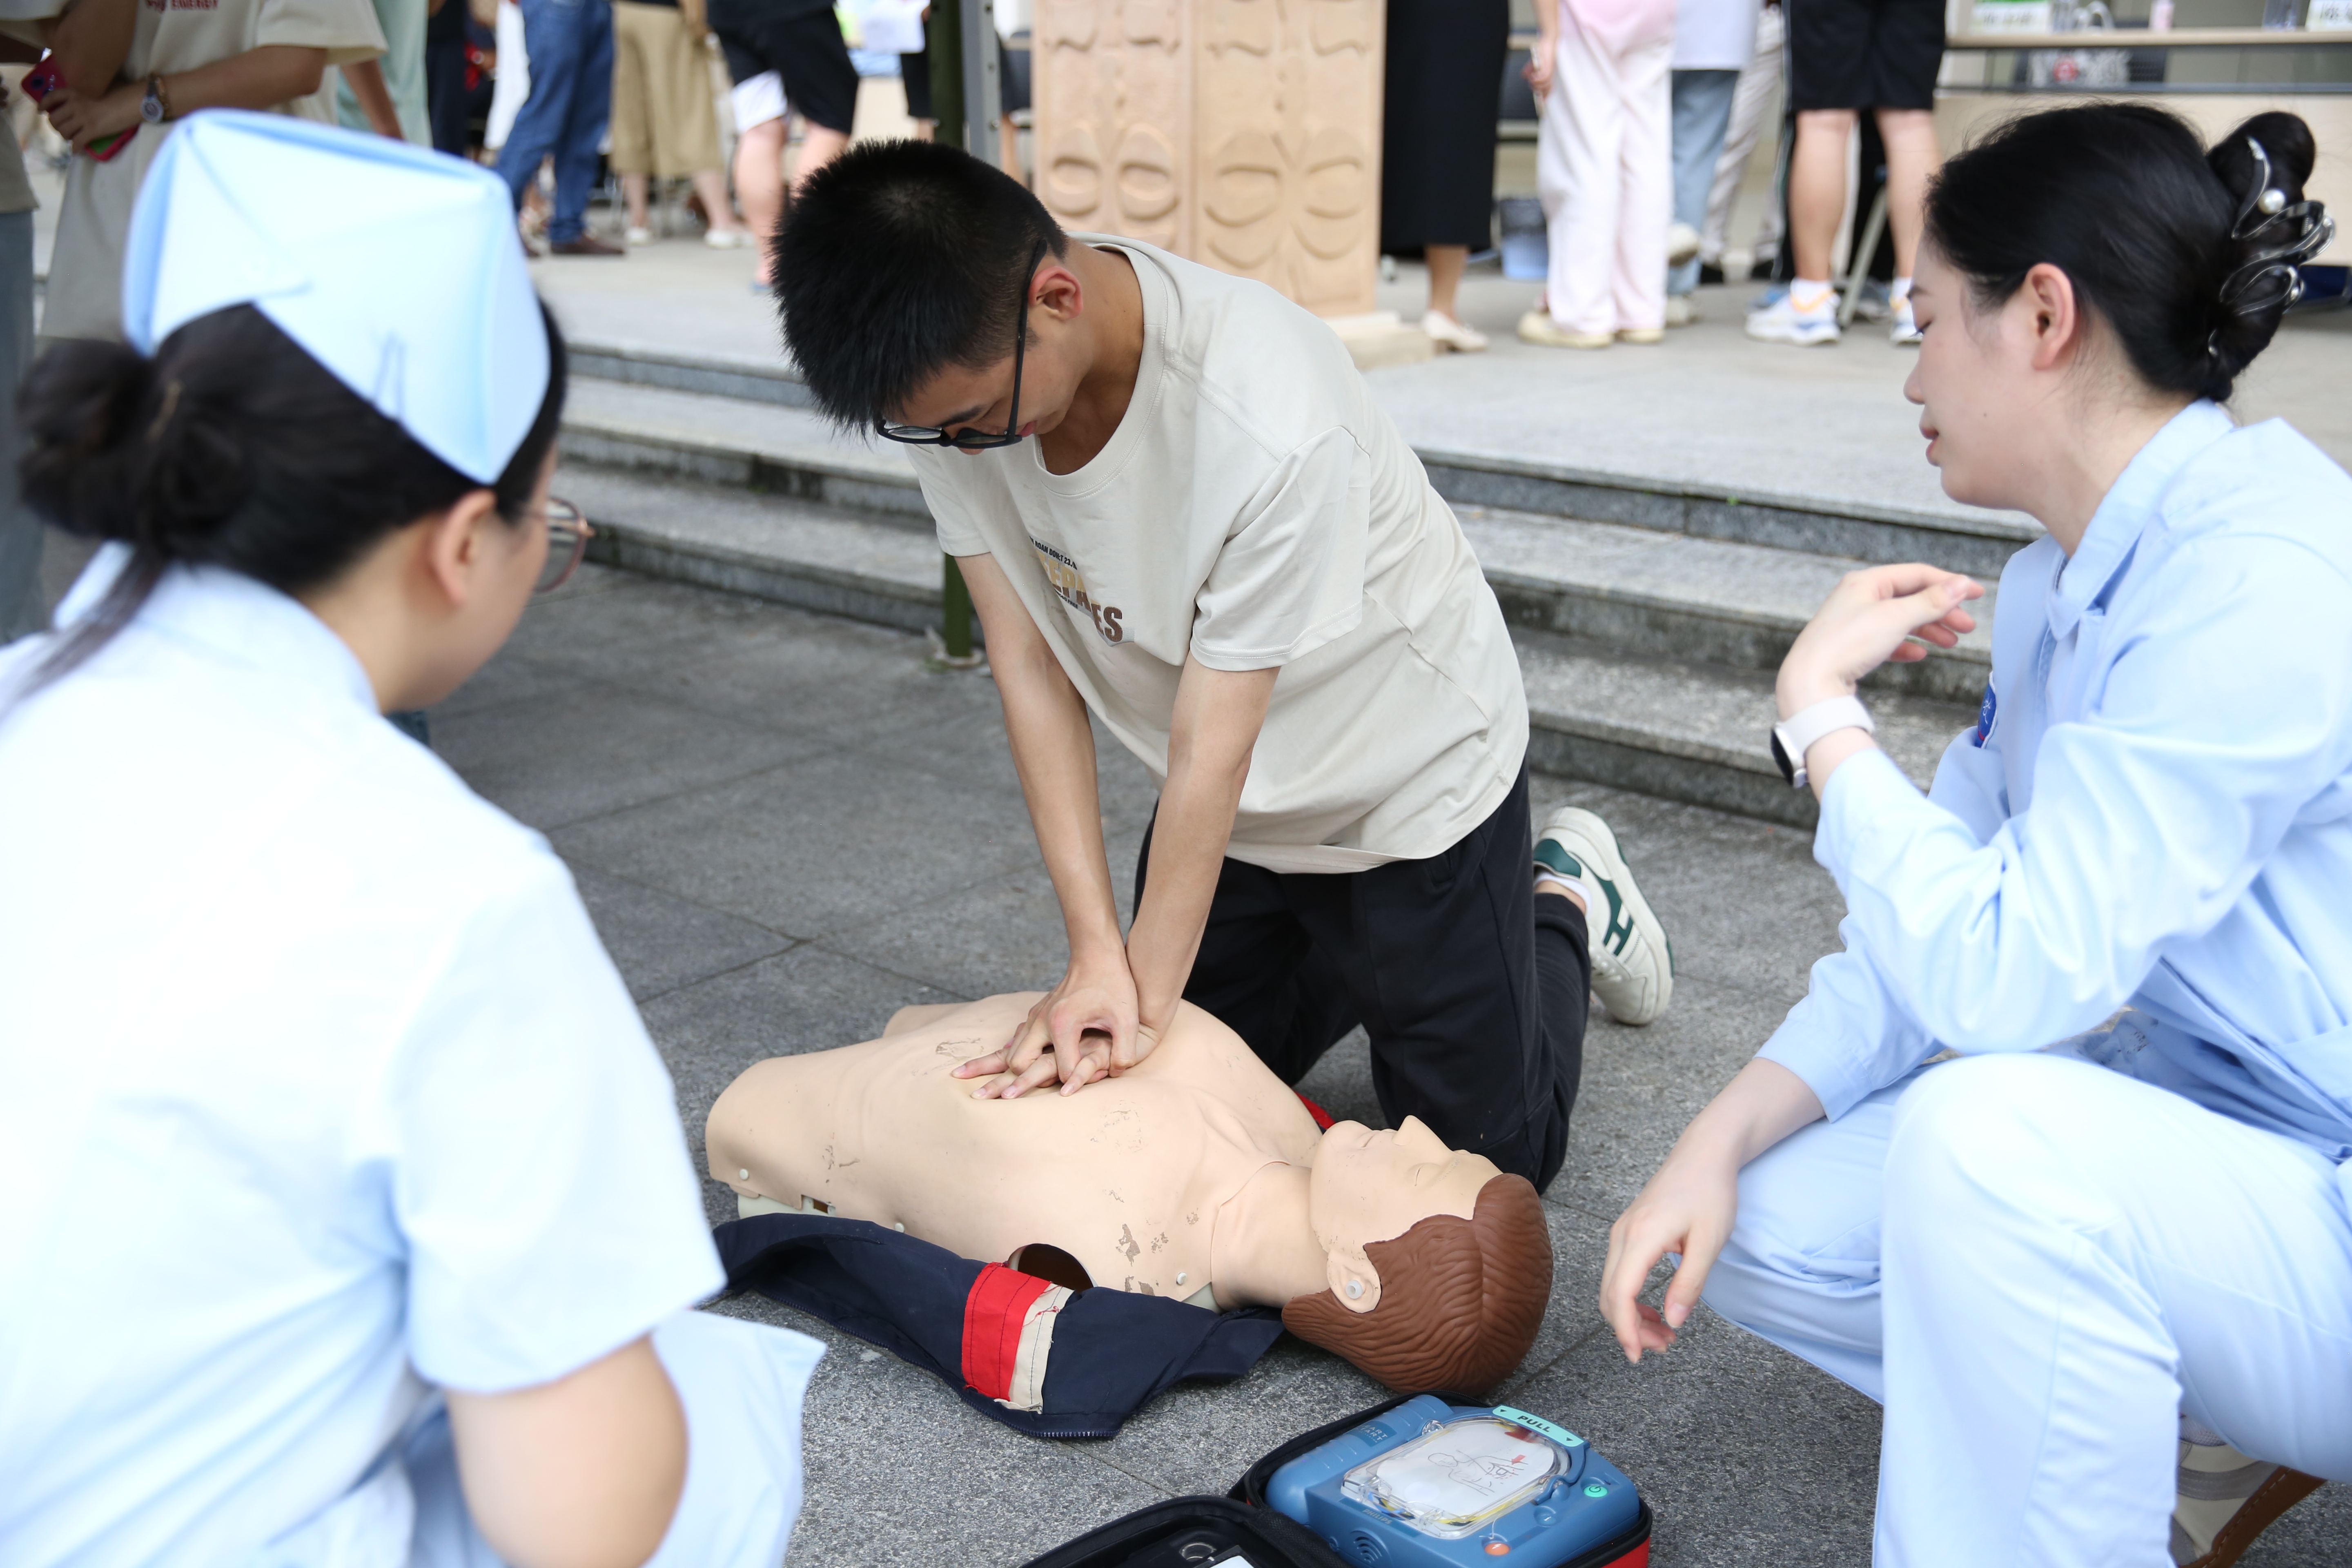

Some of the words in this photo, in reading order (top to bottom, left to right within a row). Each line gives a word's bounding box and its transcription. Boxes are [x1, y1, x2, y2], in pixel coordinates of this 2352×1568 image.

[1362, 1425, 1388, 1437] EART
[1517, 1415, 1551, 1432] PULL
[1362, 1509, 1392, 1524] PHILIPS
